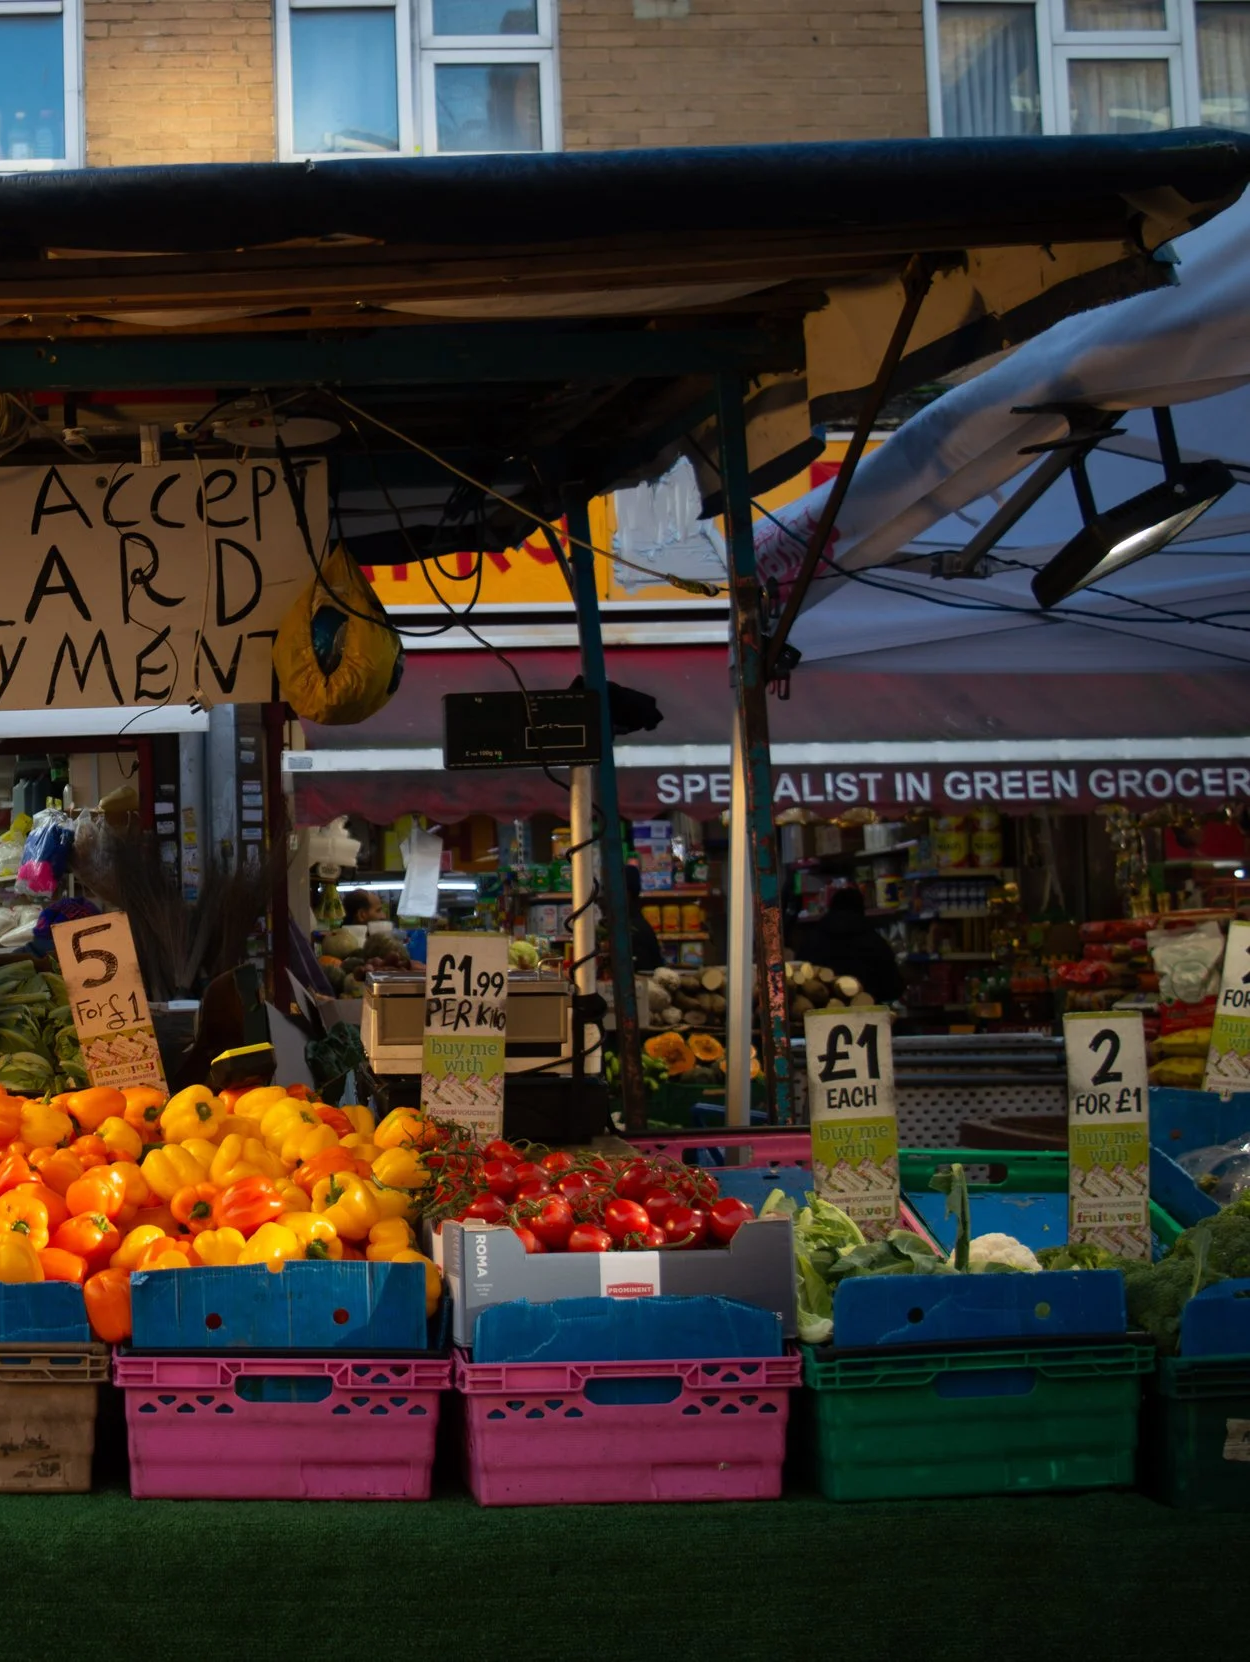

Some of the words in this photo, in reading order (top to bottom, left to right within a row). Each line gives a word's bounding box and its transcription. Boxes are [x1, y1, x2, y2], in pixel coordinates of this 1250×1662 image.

[657, 771, 882, 804] SPEALIST
[896, 771, 931, 802] IN
[943, 768, 1077, 800] GREEN
[72, 923, 119, 989] 5
[431, 953, 505, 998] £1.99
[425, 998, 472, 1031] PER
[431, 1039, 466, 1059] buy
[470, 1043, 499, 1056] me
[817, 1023, 881, 1083] £1
[1089, 1029, 1123, 1087] 2
[444, 1056, 485, 1074] with
[827, 1085, 878, 1109] EACH
[1076, 1093, 1111, 1115] FOR
[1116, 1087, 1143, 1113] £1
[819, 1125, 856, 1144] buy
[860, 1125, 889, 1139] me
[834, 1142, 877, 1159] with
[475, 1234, 488, 1278] ROMA
[607, 1286, 651, 1294] PROMINENT
